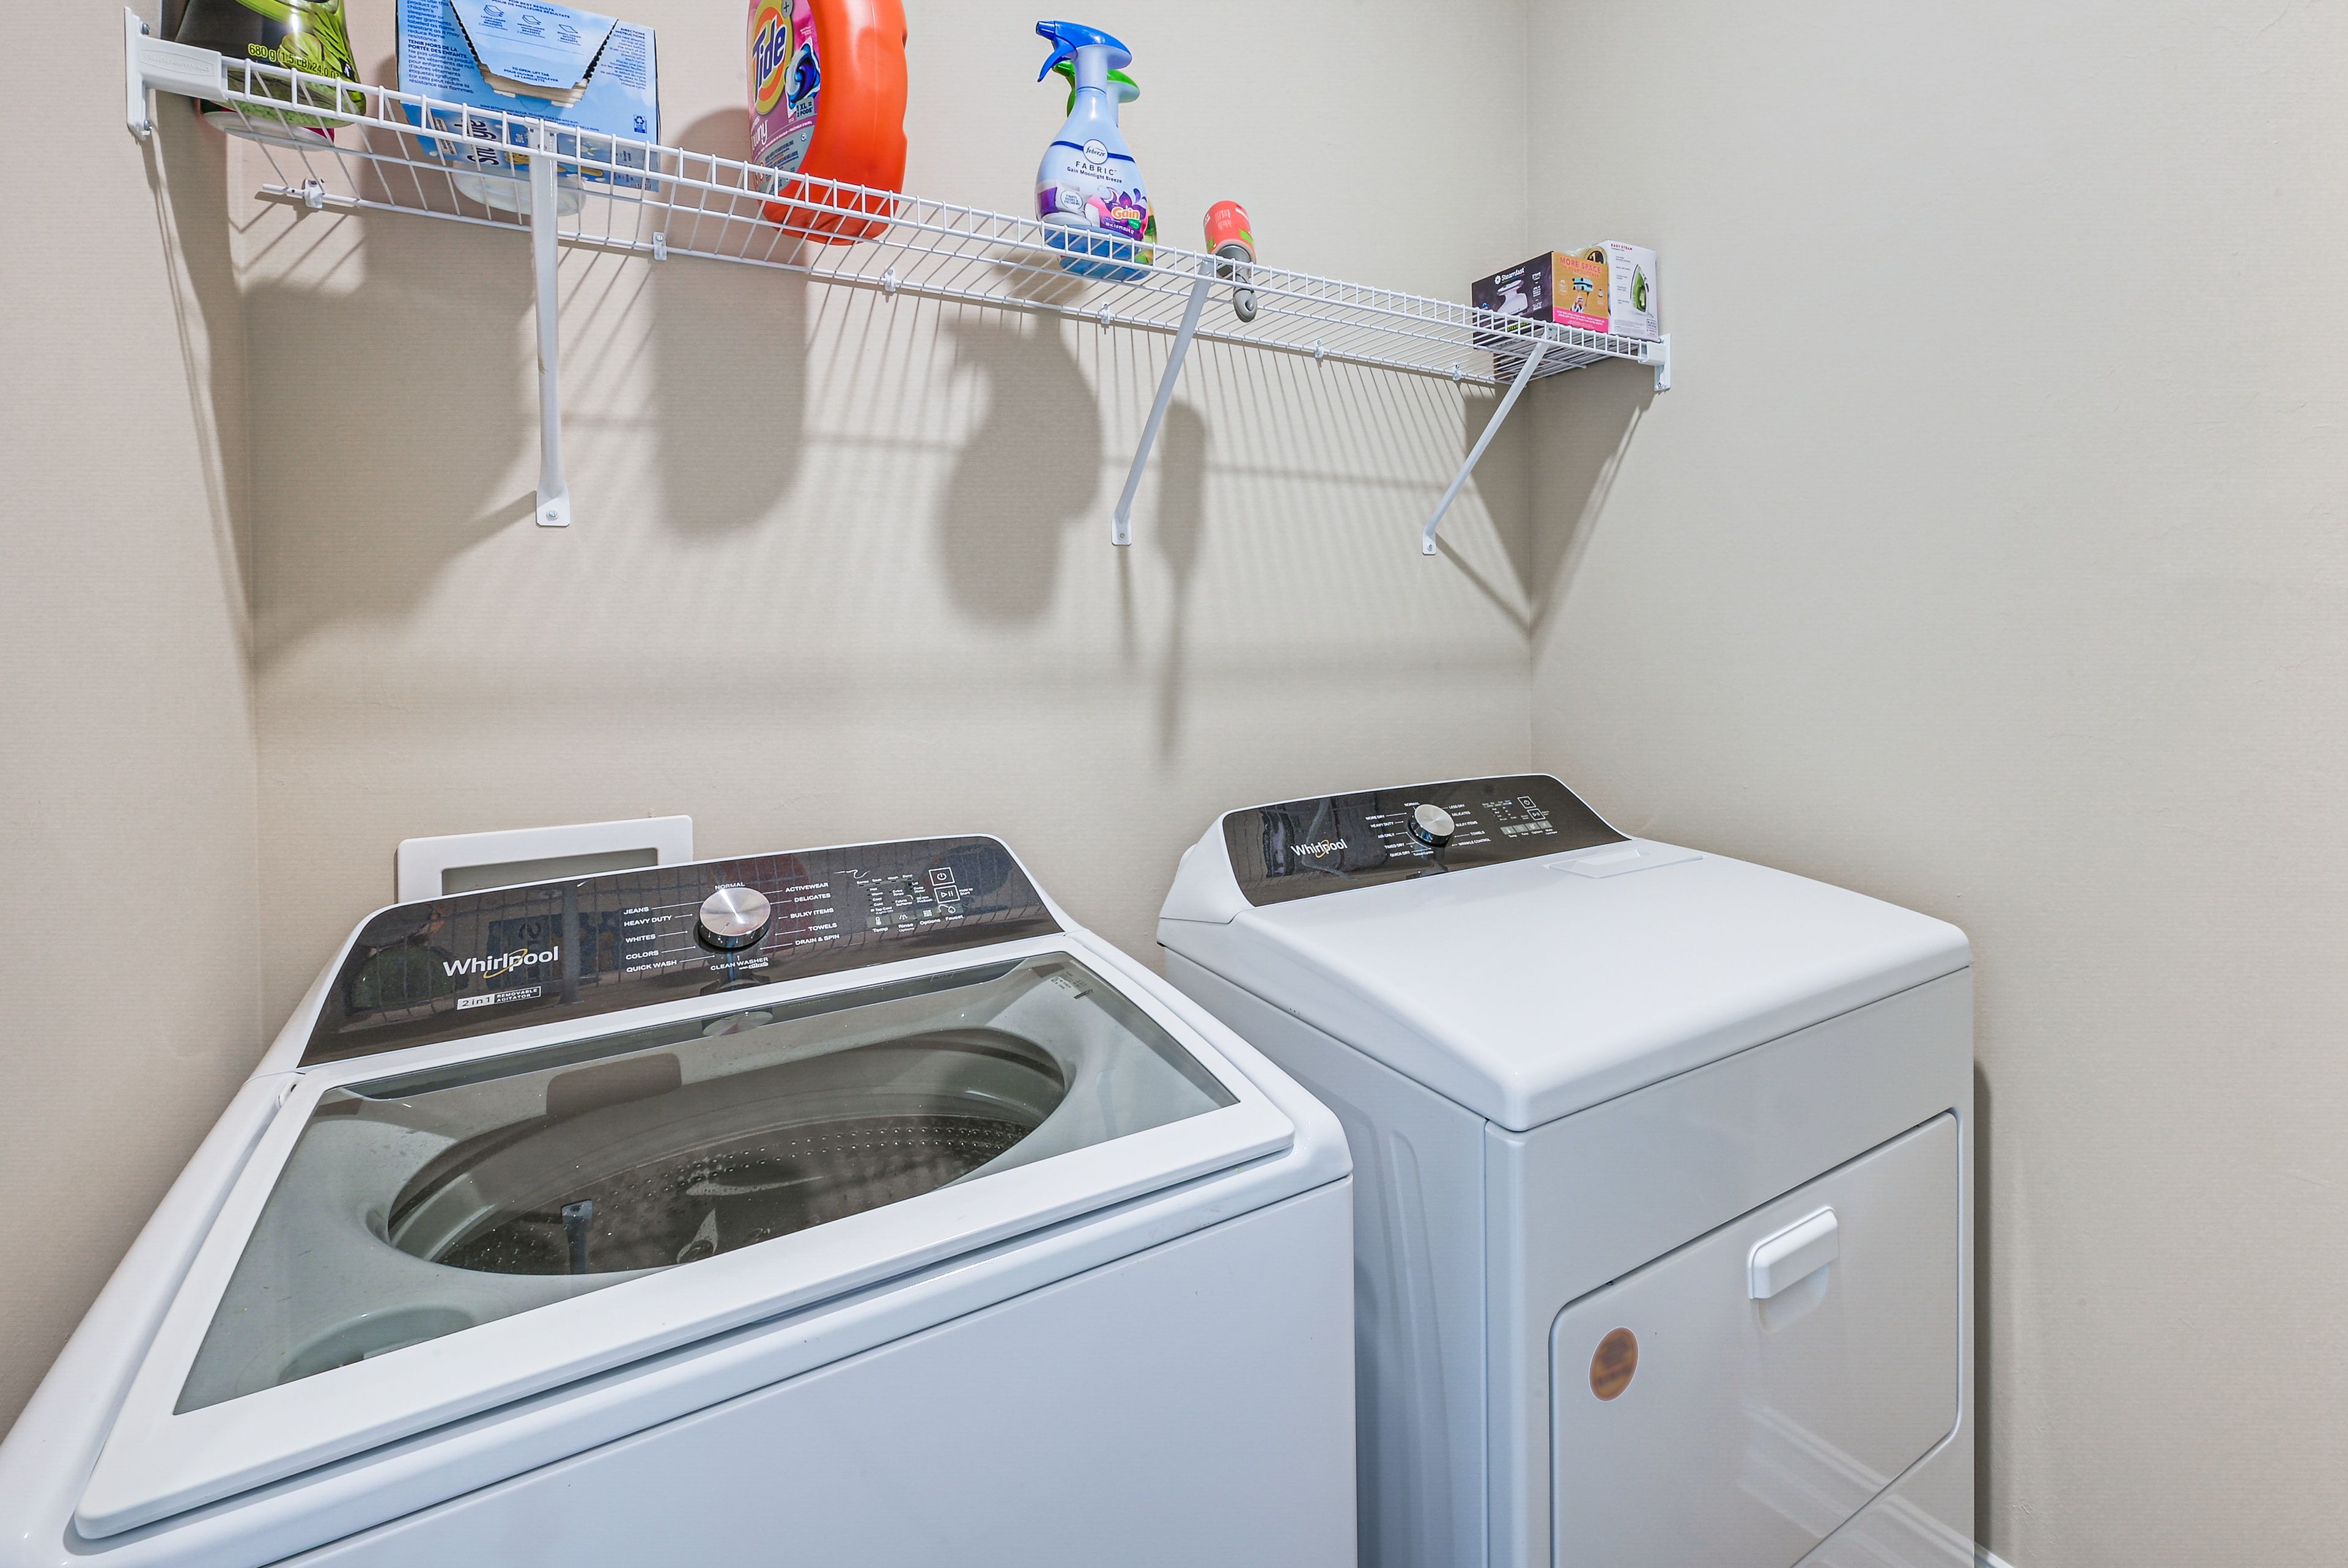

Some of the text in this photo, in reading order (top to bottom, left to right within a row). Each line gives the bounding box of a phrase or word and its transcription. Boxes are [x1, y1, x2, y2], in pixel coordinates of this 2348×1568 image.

[424, 18, 451, 26] garments
[616, 31, 644, 39] INSTRUCTIONS
[249, 45, 267, 57] 680
[270, 50, 275, 61] g
[443, 50, 468, 59] ENFANTS.
[427, 57, 455, 66] vêtements
[753, 16, 786, 105] Tide
[800, 108, 812, 117] PODS
[1086, 145, 1105, 156] febreze
[1076, 161, 1113, 175] FABRIC
[1080, 170, 1104, 179] Moonlight
[1111, 207, 1140, 219] Gain
[1560, 257, 1601, 273] MORE SPACE
[1502, 267, 1524, 281] Steamfast
[1291, 839, 1348, 856] Whirlpool
[715, 882, 745, 890] NORMAL
[785, 882, 829, 893] ACTIVEWEAR
[794, 893, 831, 903] DELICATES
[623, 906, 649, 915] JEANS
[790, 907, 834, 919] BULKY ITEMS
[624, 915, 672, 927] HEAVY DUTY
[808, 922, 837, 932] TOWELS
[626, 934, 656, 943] WHITES
[626, 950, 659, 960] COLORS
[443, 946, 559, 977] Whirlpool
[626, 959, 677, 973] QUICK WASH
[711, 962, 736, 971] CLEAN
[736, 957, 769, 967] WASHER
[497, 988, 537, 998] REMOVABLE
[497, 993, 531, 1003] AGITATOR
